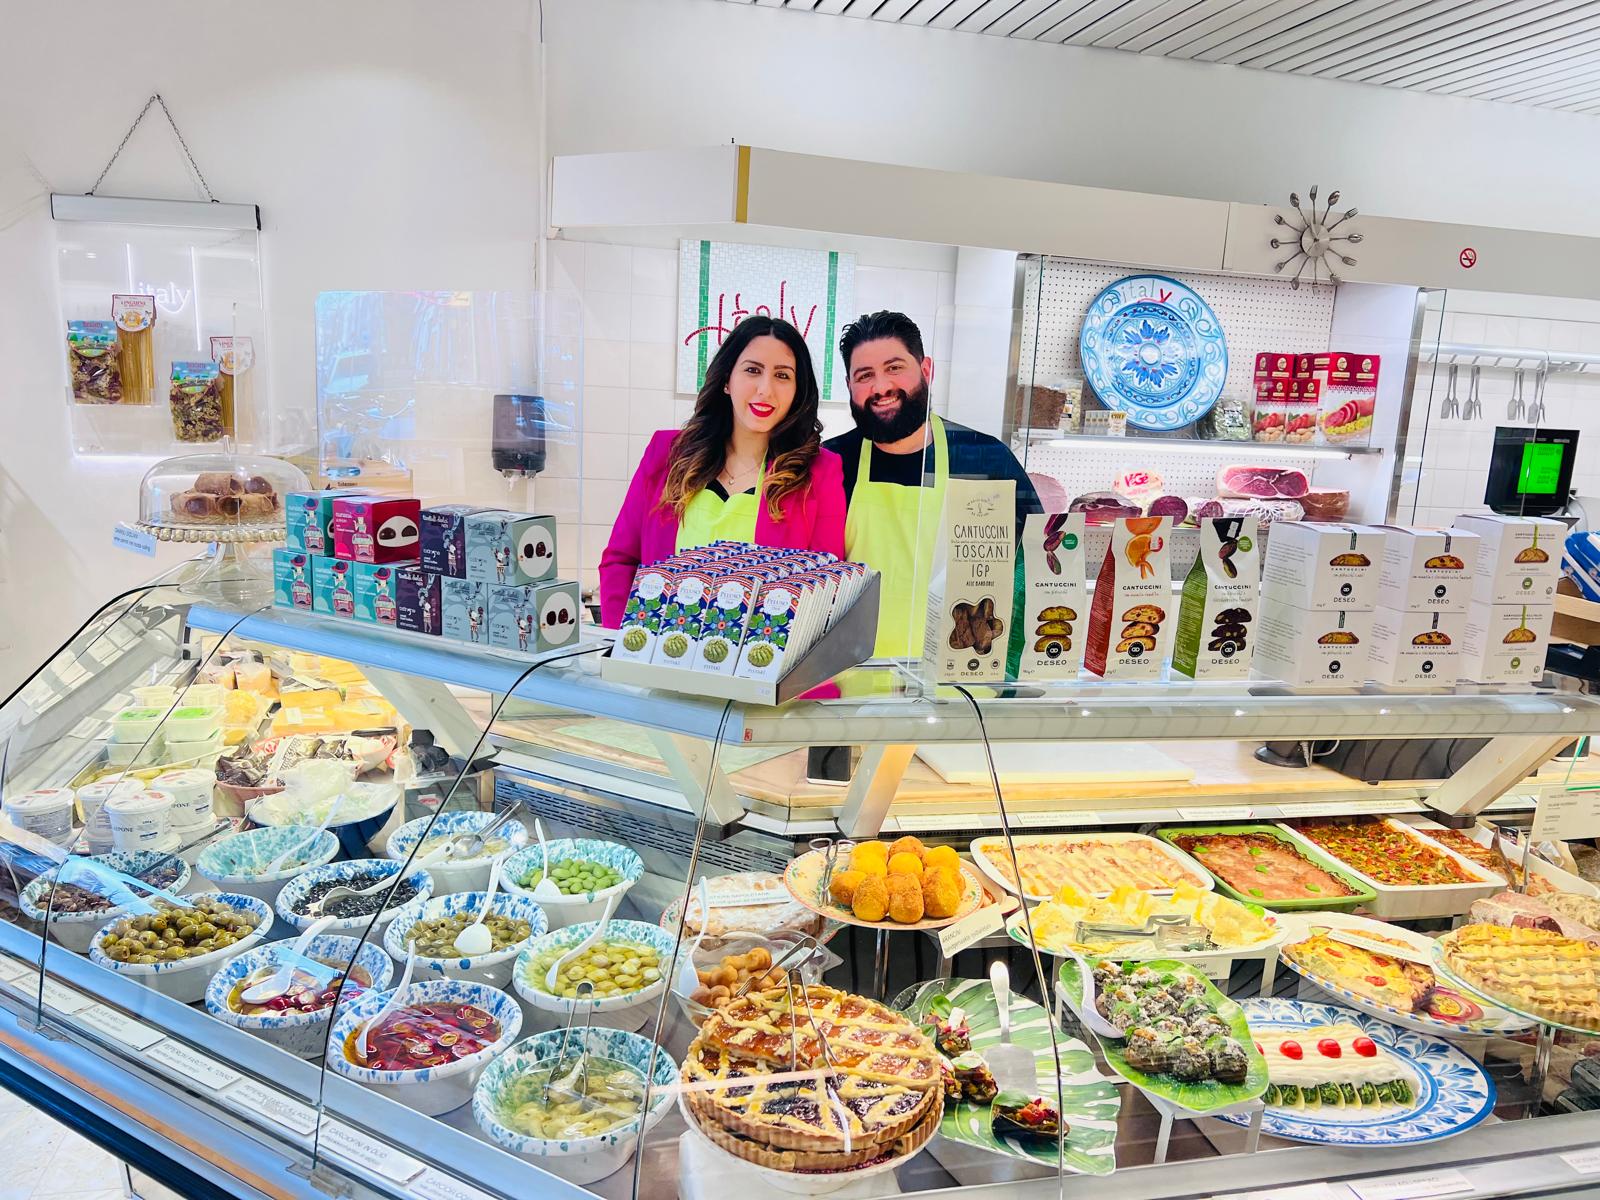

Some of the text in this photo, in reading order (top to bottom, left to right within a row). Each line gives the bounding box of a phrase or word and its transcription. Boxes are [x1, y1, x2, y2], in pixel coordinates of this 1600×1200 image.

[1121, 279, 1173, 303] italy
[954, 524, 1009, 539] CANTUCCINI
[955, 544, 1009, 559] TOSCANI
[971, 563, 990, 578] IGP
